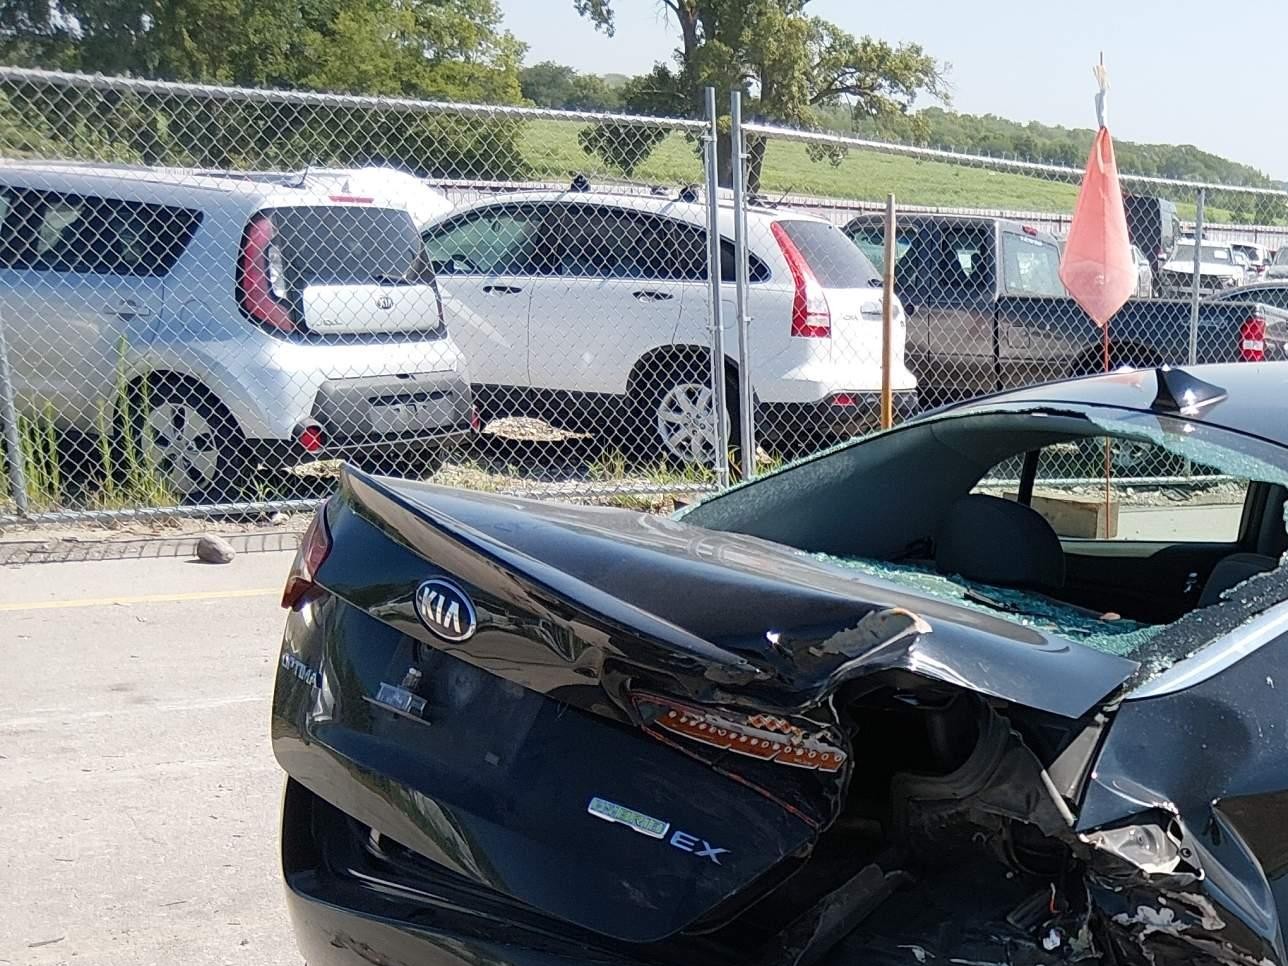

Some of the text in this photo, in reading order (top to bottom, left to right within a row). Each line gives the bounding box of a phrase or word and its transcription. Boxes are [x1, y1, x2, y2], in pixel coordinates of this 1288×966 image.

[421, 586, 462, 634] KIA
[282, 652, 318, 689] OPTIMA
[670, 830, 733, 867] EX
